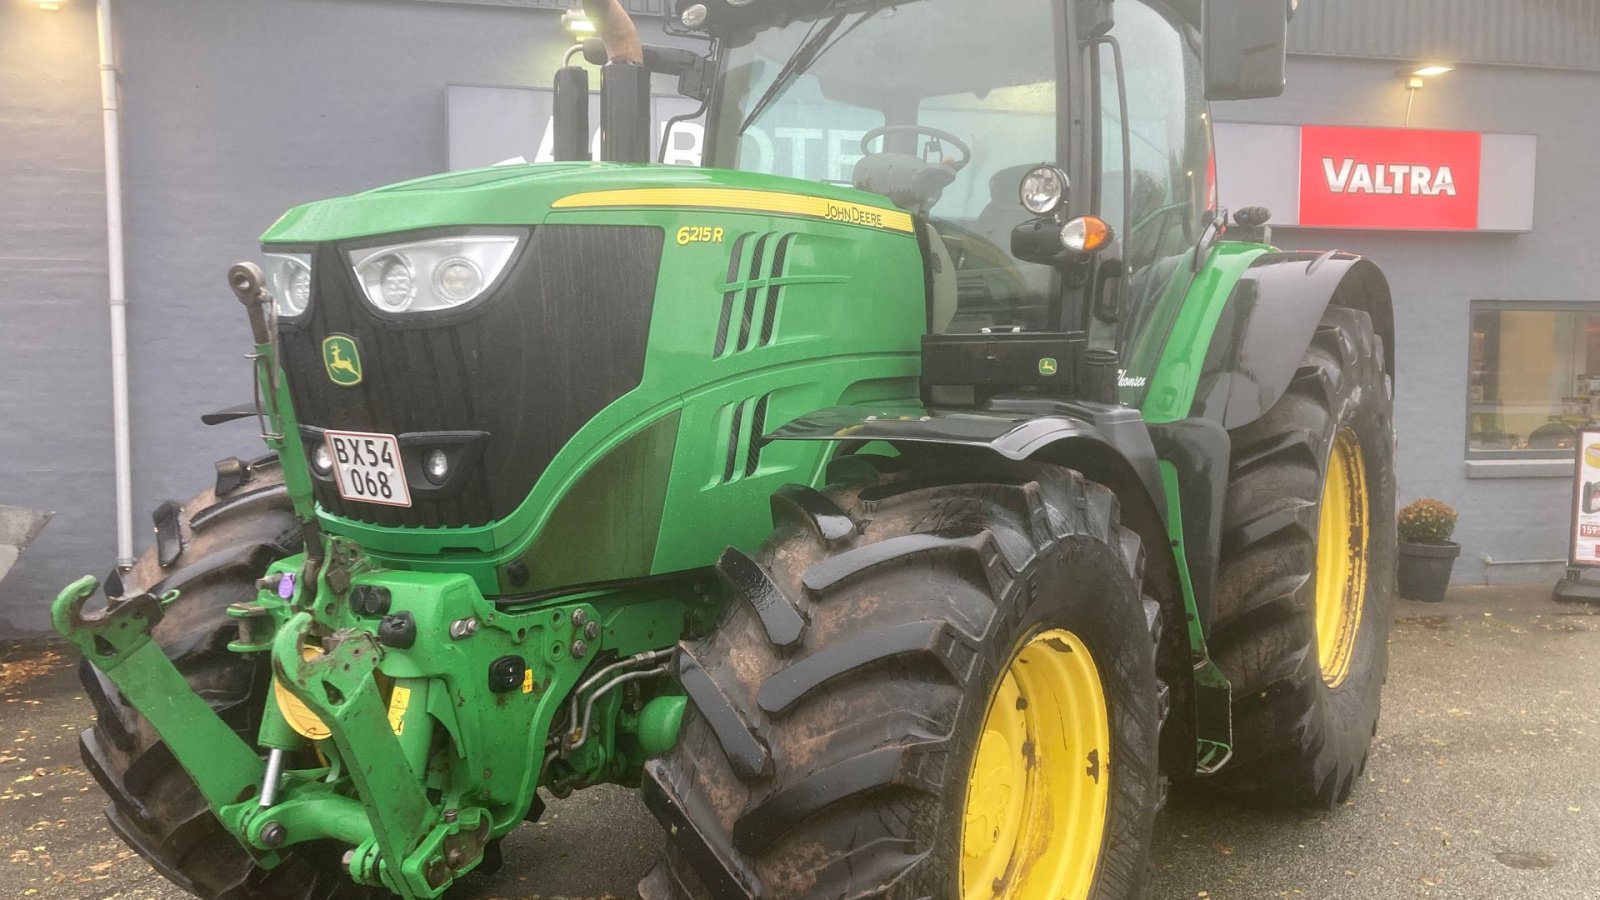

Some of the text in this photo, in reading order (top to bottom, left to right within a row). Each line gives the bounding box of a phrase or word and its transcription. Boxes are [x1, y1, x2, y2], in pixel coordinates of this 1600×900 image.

[1321, 157, 1456, 196] VALTRA
[333, 437, 395, 469] BX54
[350, 468, 393, 499] 068
